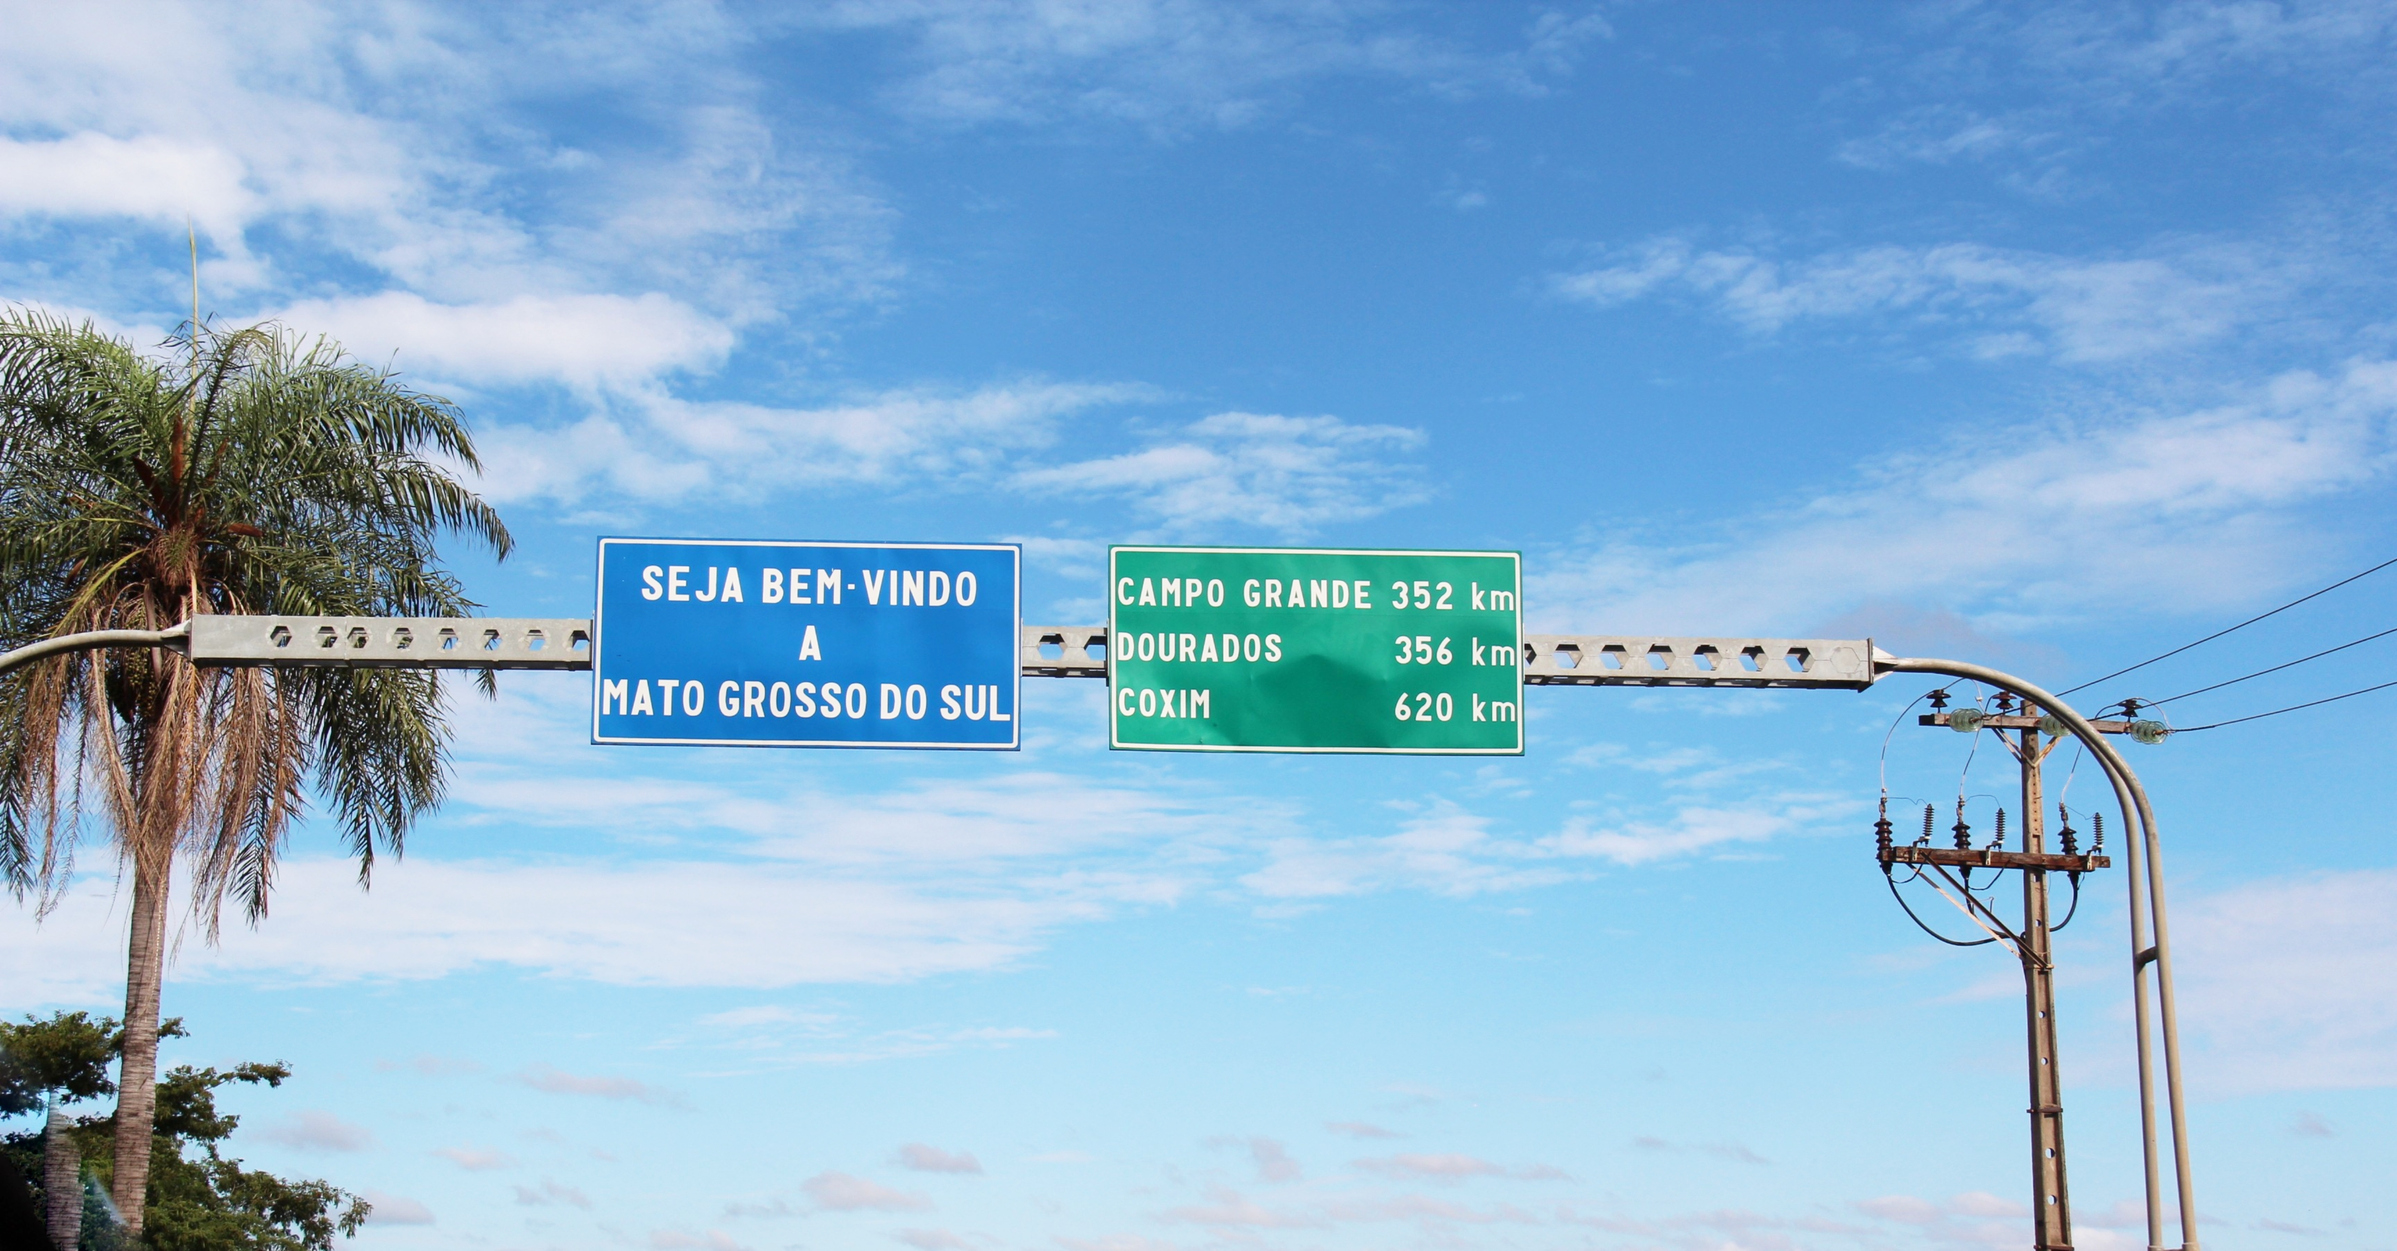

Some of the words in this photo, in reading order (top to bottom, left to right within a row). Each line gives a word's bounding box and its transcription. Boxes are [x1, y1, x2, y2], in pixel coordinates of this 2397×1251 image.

[641, 565, 744, 603] SEJA
[762, 568, 977, 607] BEM-VINDO
[1117, 577, 1224, 607] CAMPO
[1243, 578, 1372, 609] GRANDE
[1392, 580, 1453, 610] 352
[1471, 581, 1514, 611] km
[798, 625, 822, 661] A
[1117, 632, 1282, 663] DOURADOS
[1395, 635, 1453, 665] 356
[1472, 637, 1515, 666] km
[602, 678, 705, 717] MATO
[718, 680, 867, 719] GROSSO
[880, 683, 927, 720] DO
[940, 684, 1011, 721] SUL
[1118, 687, 1210, 719] COXIM
[1395, 692, 1453, 722] 620
[1472, 693, 1516, 722] km
